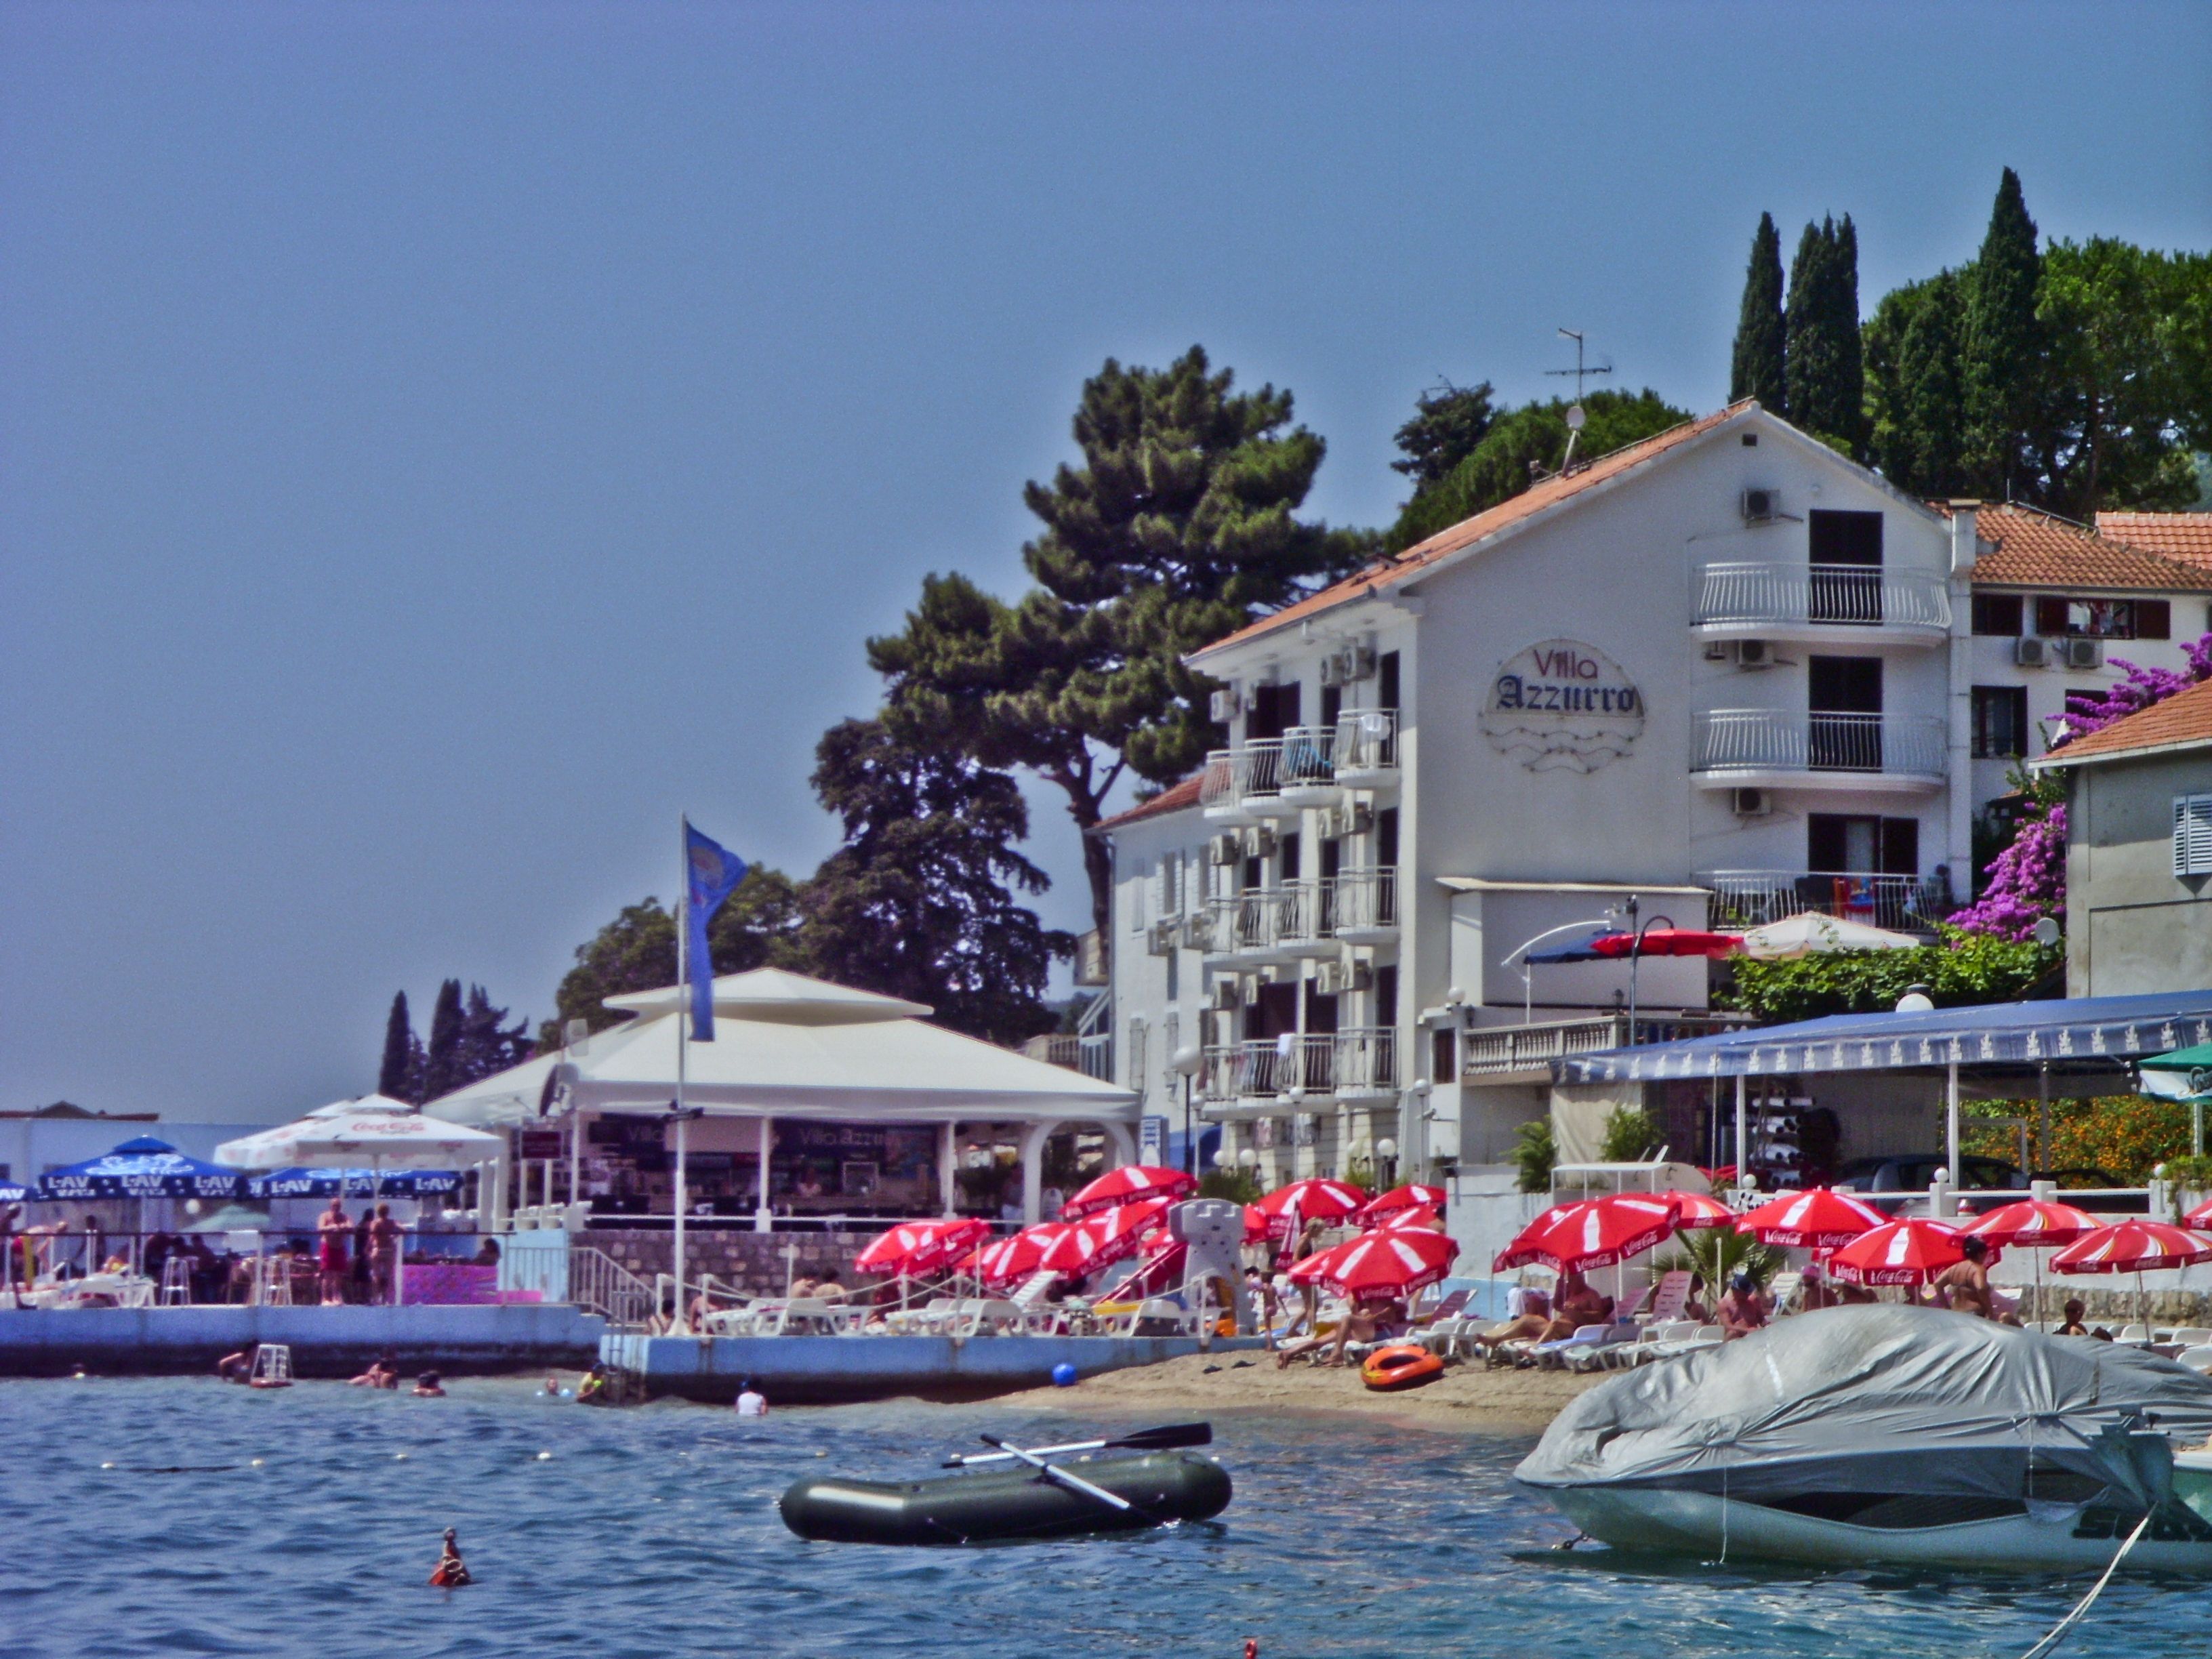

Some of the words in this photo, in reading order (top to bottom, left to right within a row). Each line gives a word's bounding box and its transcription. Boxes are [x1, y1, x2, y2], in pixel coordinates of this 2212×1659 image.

[1534, 649, 1598, 680] Villa
[1496, 674, 1635, 712] Azzurro
[1770, 1230, 1803, 1245] Coca-Cola
[1581, 1253, 1612, 1270] Coca-Cola
[1876, 1269, 1914, 1283] Coca-Cola
